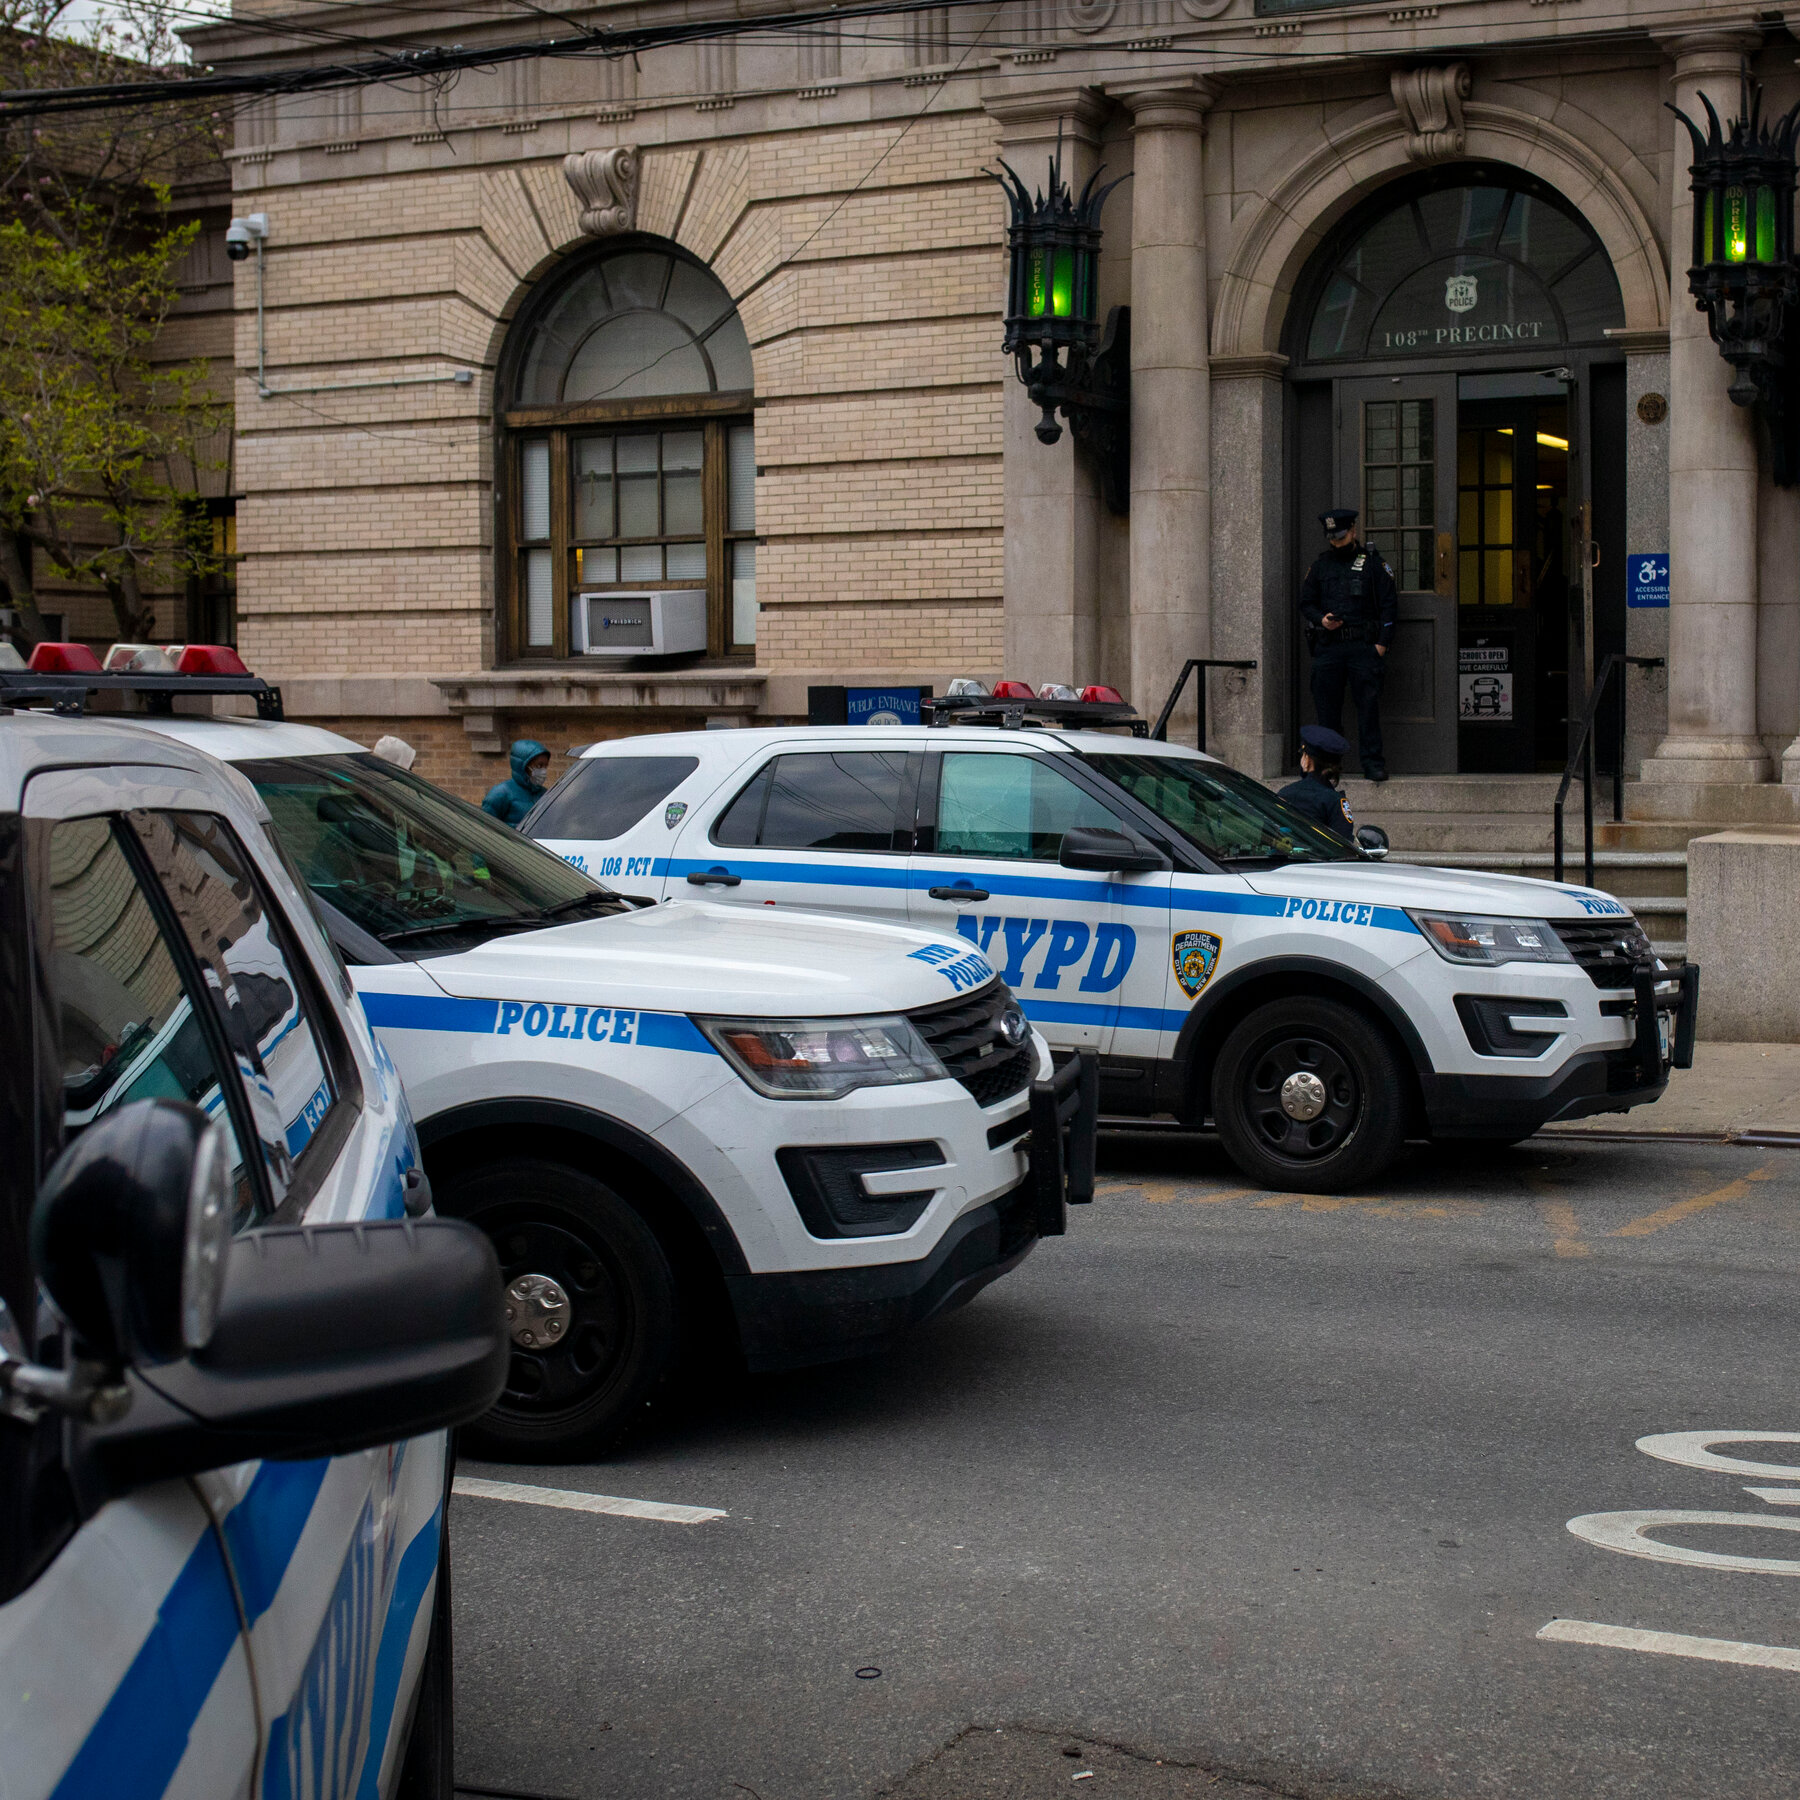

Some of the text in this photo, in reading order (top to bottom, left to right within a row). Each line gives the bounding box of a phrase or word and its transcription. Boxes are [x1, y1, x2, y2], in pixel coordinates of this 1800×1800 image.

[1449, 297, 1473, 306] POLICE
[1435, 321, 1543, 344] PRECINCT
[1488, 650, 1504, 659] OPEN
[1473, 663, 1508, 671] CAREFULLY
[848, 695, 919, 714] PUBLIC ENTRANCE
[600, 857, 623, 876] 108
[625, 857, 652, 876] PCT
[1285, 897, 1372, 926] POLICE
[1175, 940, 1218, 953] DEPARTMENT
[1185, 933, 1211, 942] POLICE
[955, 914, 1137, 993] NYPD
[1180, 978, 1187, 986] OF
[1196, 958, 1216, 990] NEW YORK
[497, 1001, 636, 1044] POLICE
